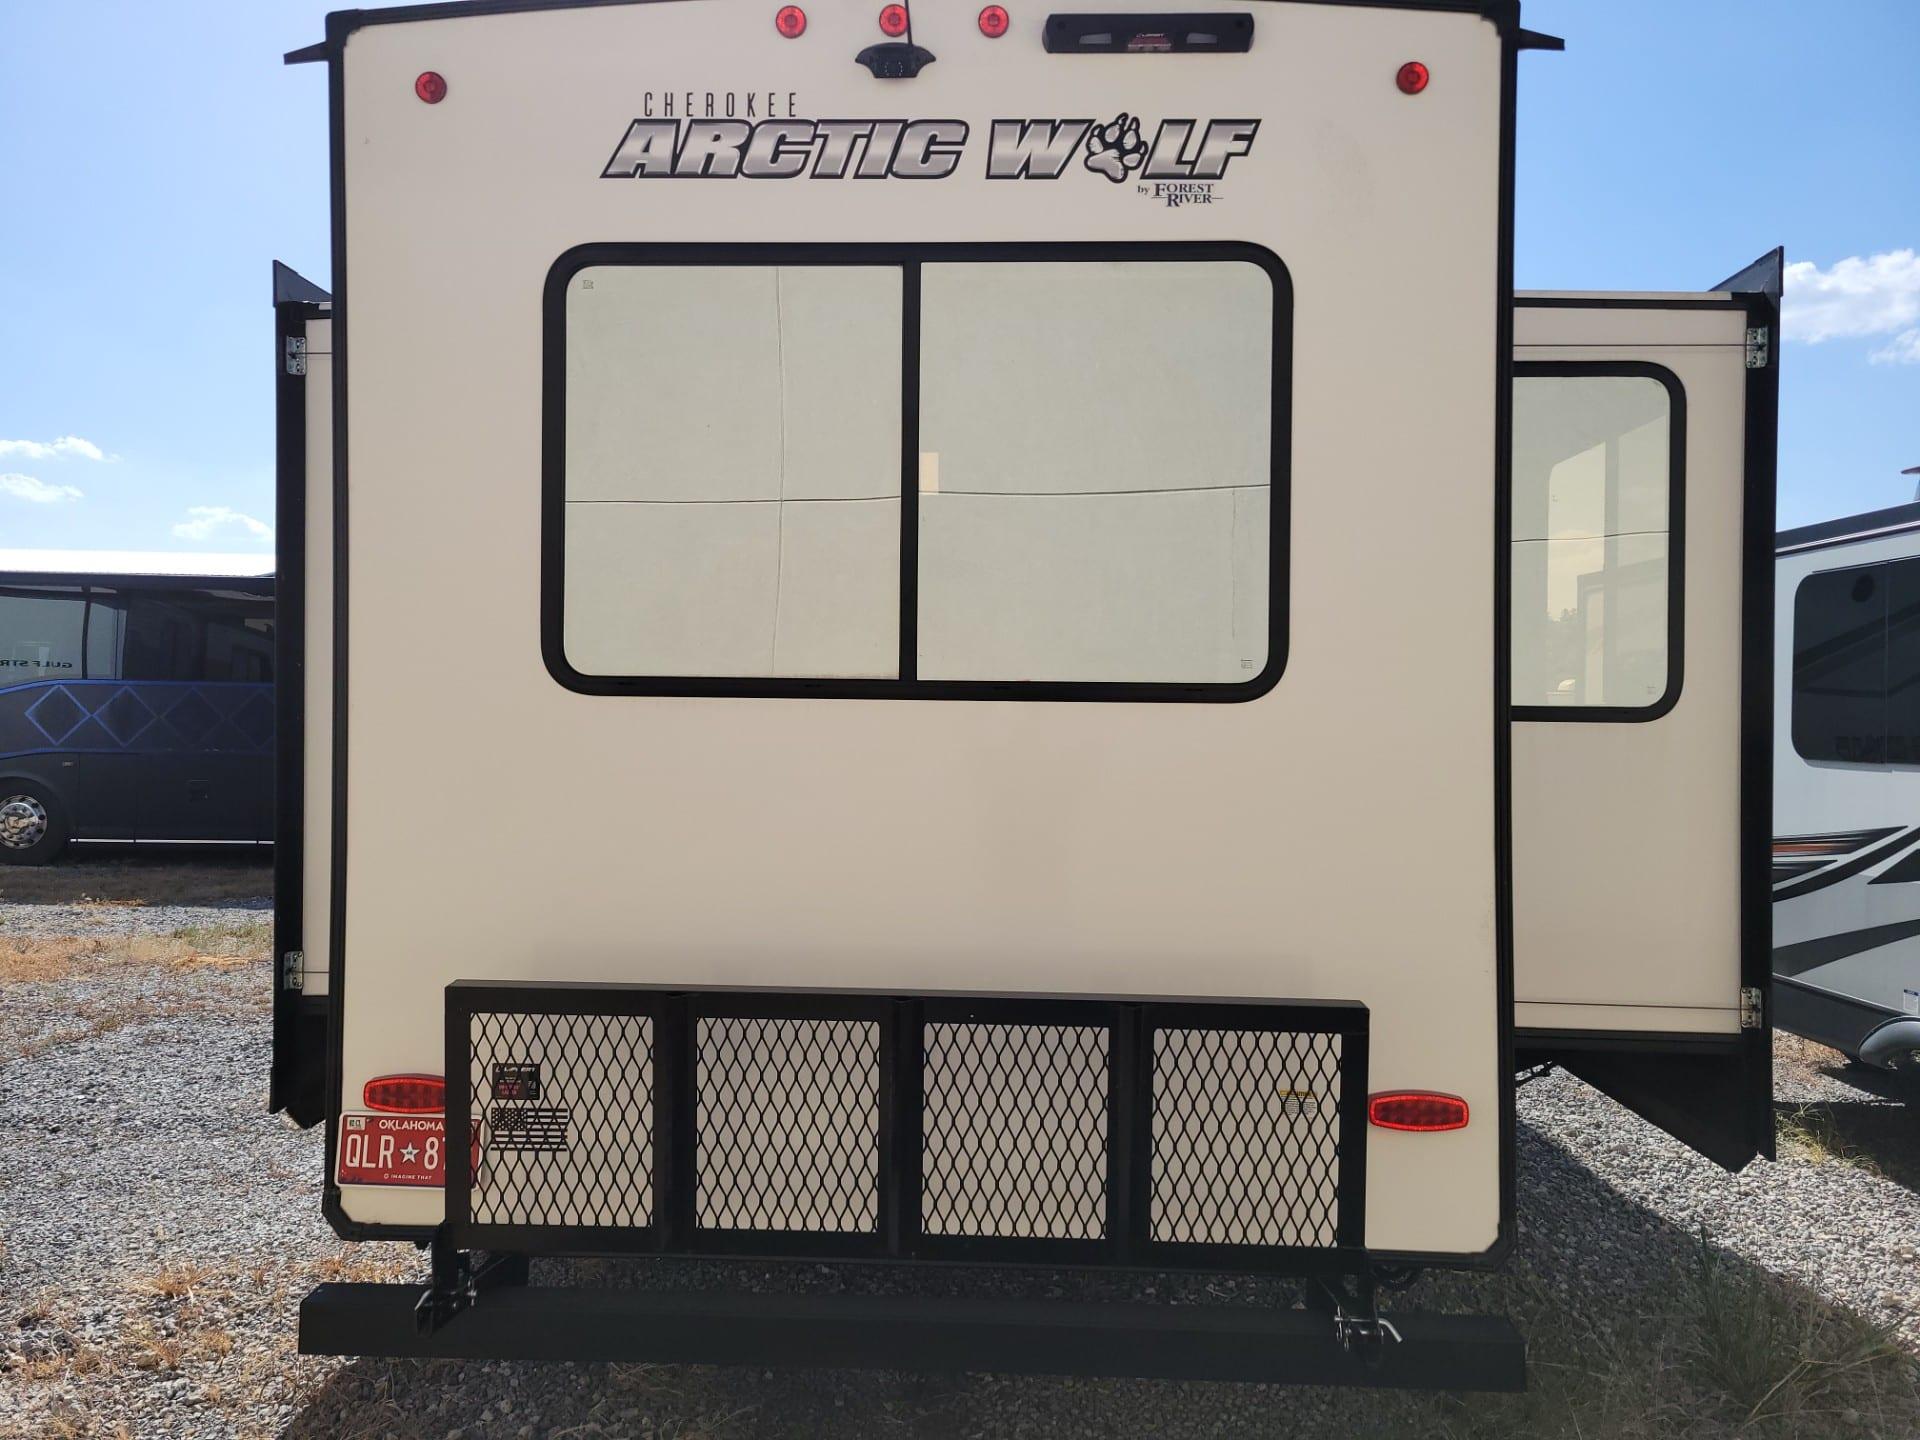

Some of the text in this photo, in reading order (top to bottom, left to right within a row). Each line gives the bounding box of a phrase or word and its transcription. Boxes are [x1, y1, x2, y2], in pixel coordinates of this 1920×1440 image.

[645, 93, 797, 118] CHEROKEE
[600, 118, 969, 180] ARCTIC
[1137, 183, 1213, 196] by FOREST
[1166, 194, 1211, 207] RIVER
[379, 1119, 444, 1131] OKLAHOMA
[345, 1134, 395, 1169] QLR
